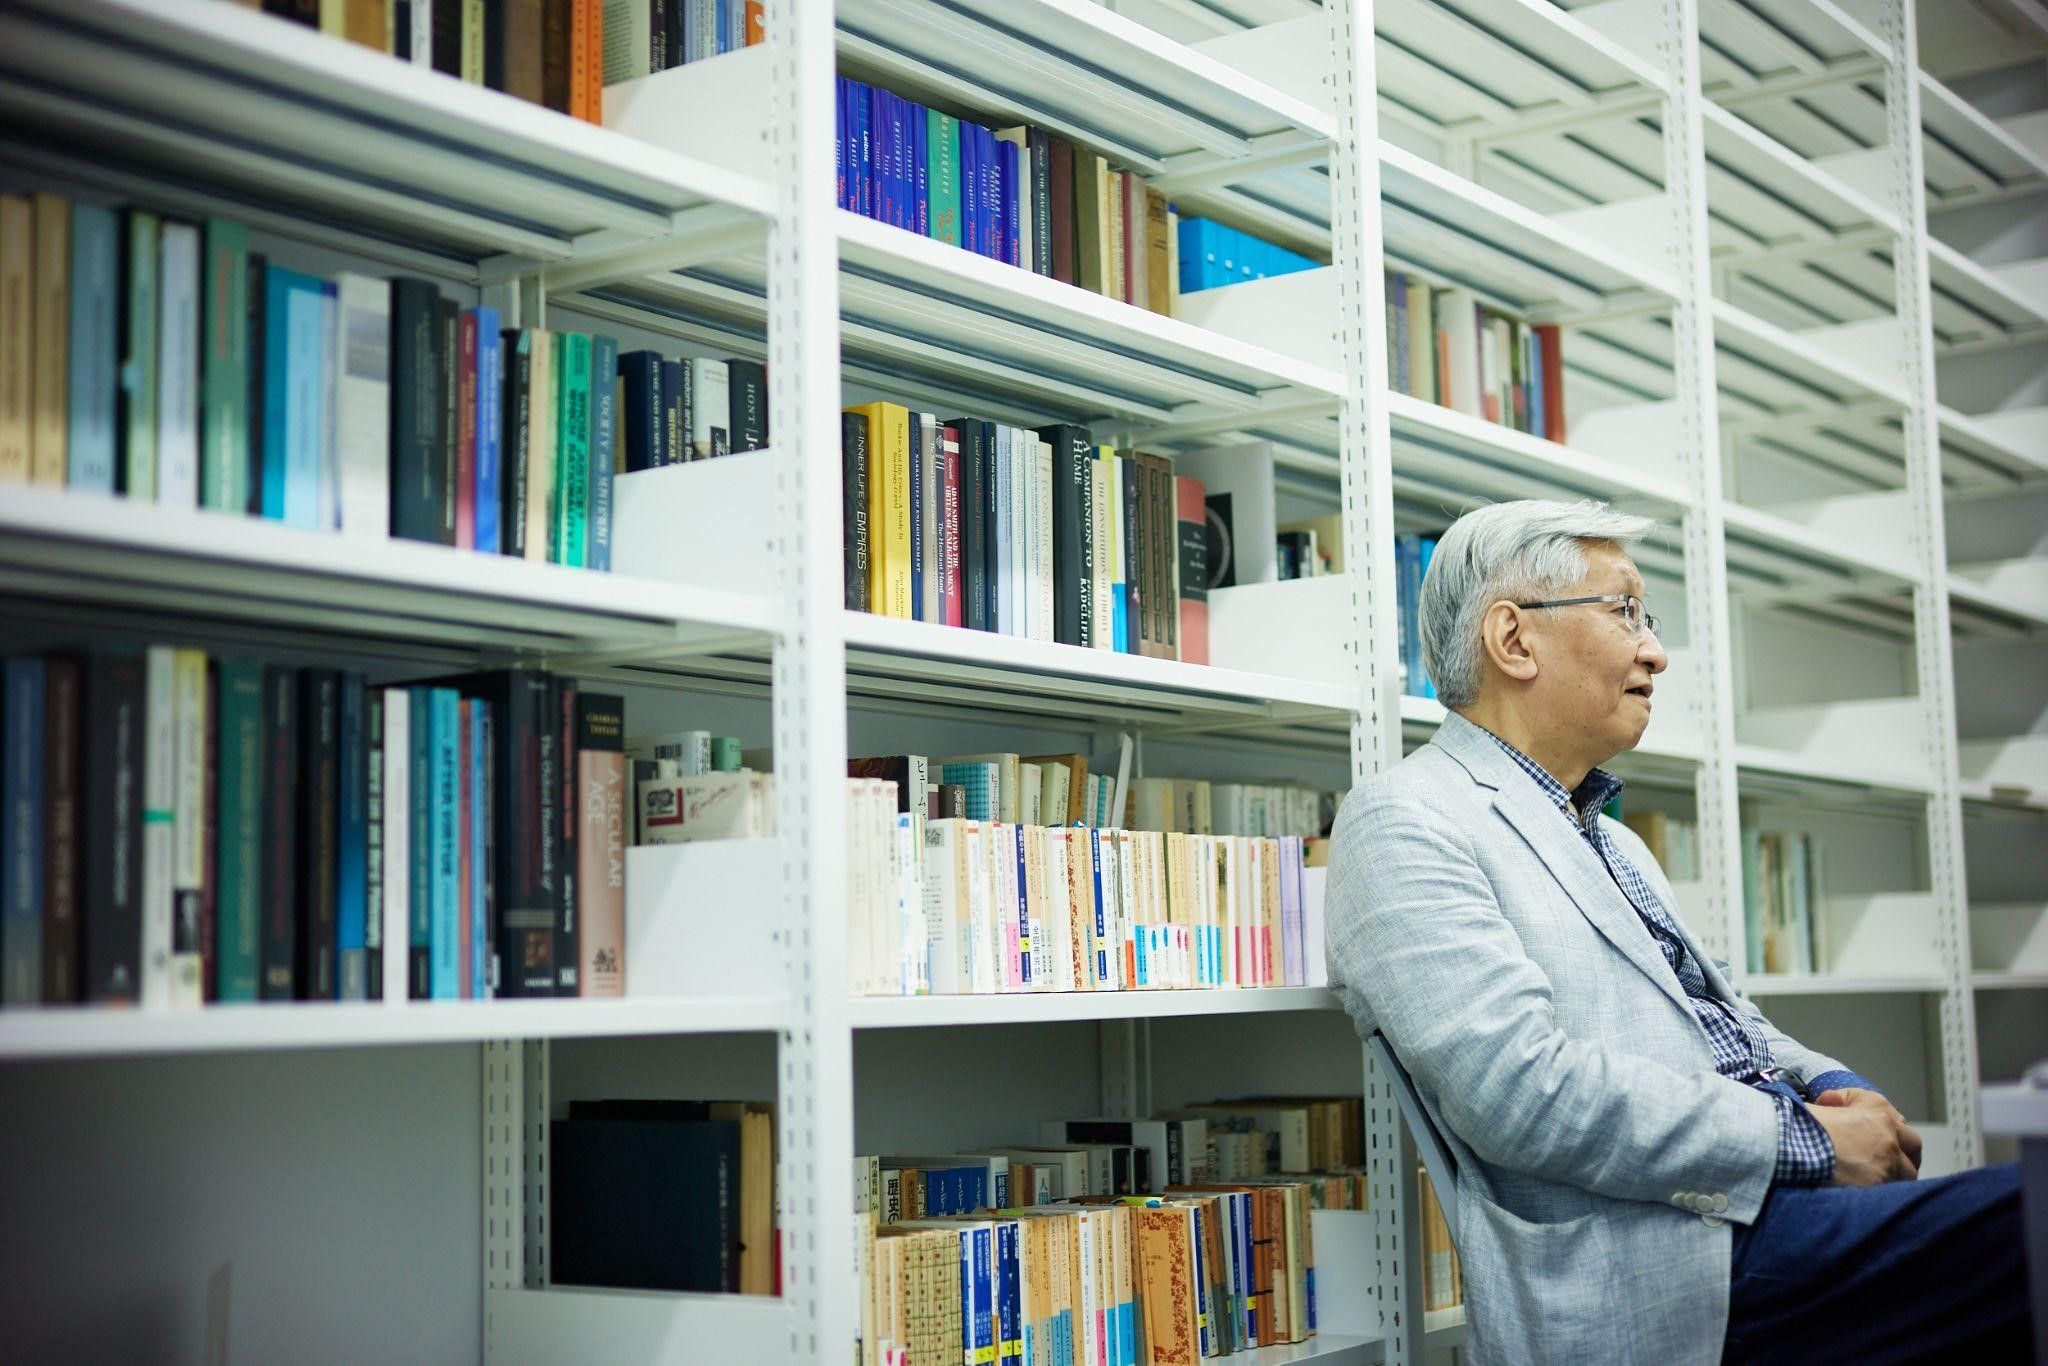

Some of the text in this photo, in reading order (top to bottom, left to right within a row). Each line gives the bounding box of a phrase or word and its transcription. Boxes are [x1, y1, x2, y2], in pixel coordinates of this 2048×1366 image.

[850, 138, 858, 168] Austin
[894, 121, 902, 179] Harrington
[941, 117, 950, 194] Montesquieu
[994, 165, 1002, 218] Constant
[1039, 191, 1047, 262] MACHIAVELLIAN
[684, 360, 692, 406] Freedom
[746, 383, 756, 425] HONT
[599, 394, 611, 448] SOCIETY
[668, 408, 676, 458] HISTORICAL
[684, 409, 692, 429] and
[684, 431, 692, 444] its
[566, 389, 577, 548] WHICH RATIONALITY?
[575, 392, 587, 519] WHOSE JUSTICE?
[857, 436, 866, 472] INNER
[1073, 438, 1084, 485] HUME
[596, 476, 609, 547] SENTIMENT
[857, 474, 866, 500] LIFE
[1041, 480, 1051, 548] ECONOMIC
[1083, 440, 1093, 568] A COMPANION TO
[856, 511, 868, 570] EMPIRES
[945, 528, 954, 598] ENLIGHTENMENT
[1080, 578, 1089, 648] RADCLIFFE
[588, 779, 606, 825] AGE
[915, 759, 927, 808] ヒューム
[441, 747, 453, 877] AFTER VIRTUE
[607, 768, 623, 888] A SECULAR
[887, 1178, 901, 1225] 歴史の
